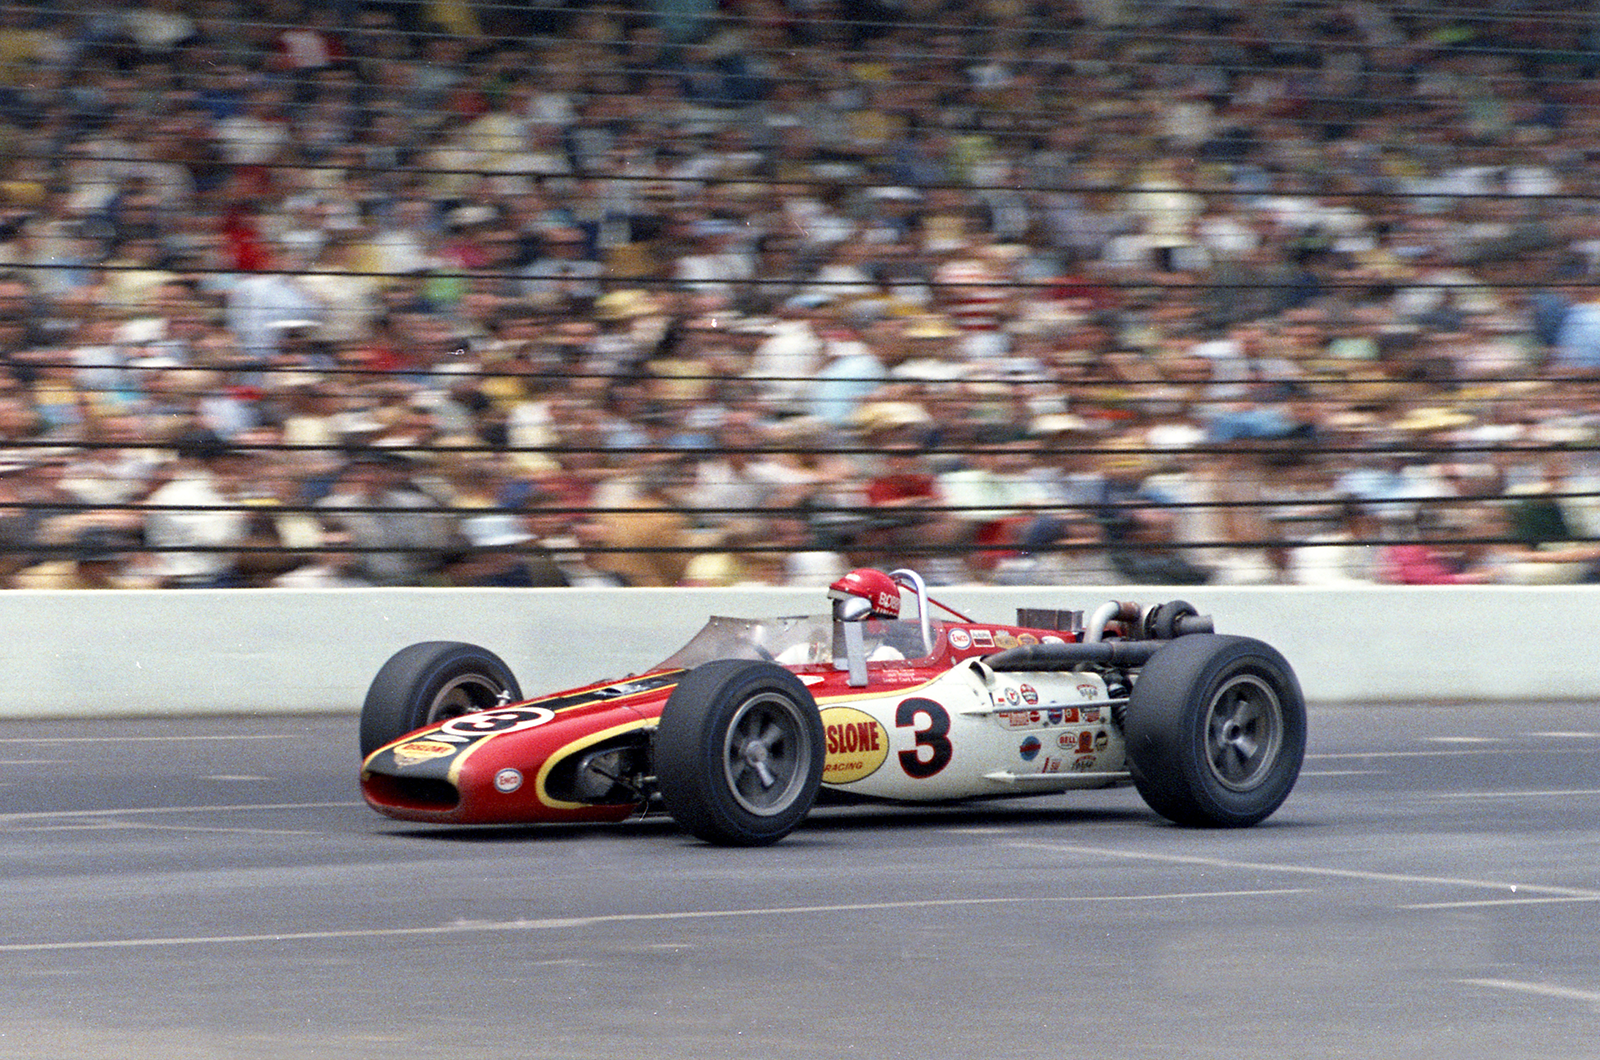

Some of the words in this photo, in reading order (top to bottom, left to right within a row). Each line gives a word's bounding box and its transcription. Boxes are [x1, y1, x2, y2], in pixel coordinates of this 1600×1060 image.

[451, 710, 542, 733] 3
[823, 721, 880, 754] SLONE
[896, 697, 953, 779] 3
[823, 761, 863, 772] RACING
